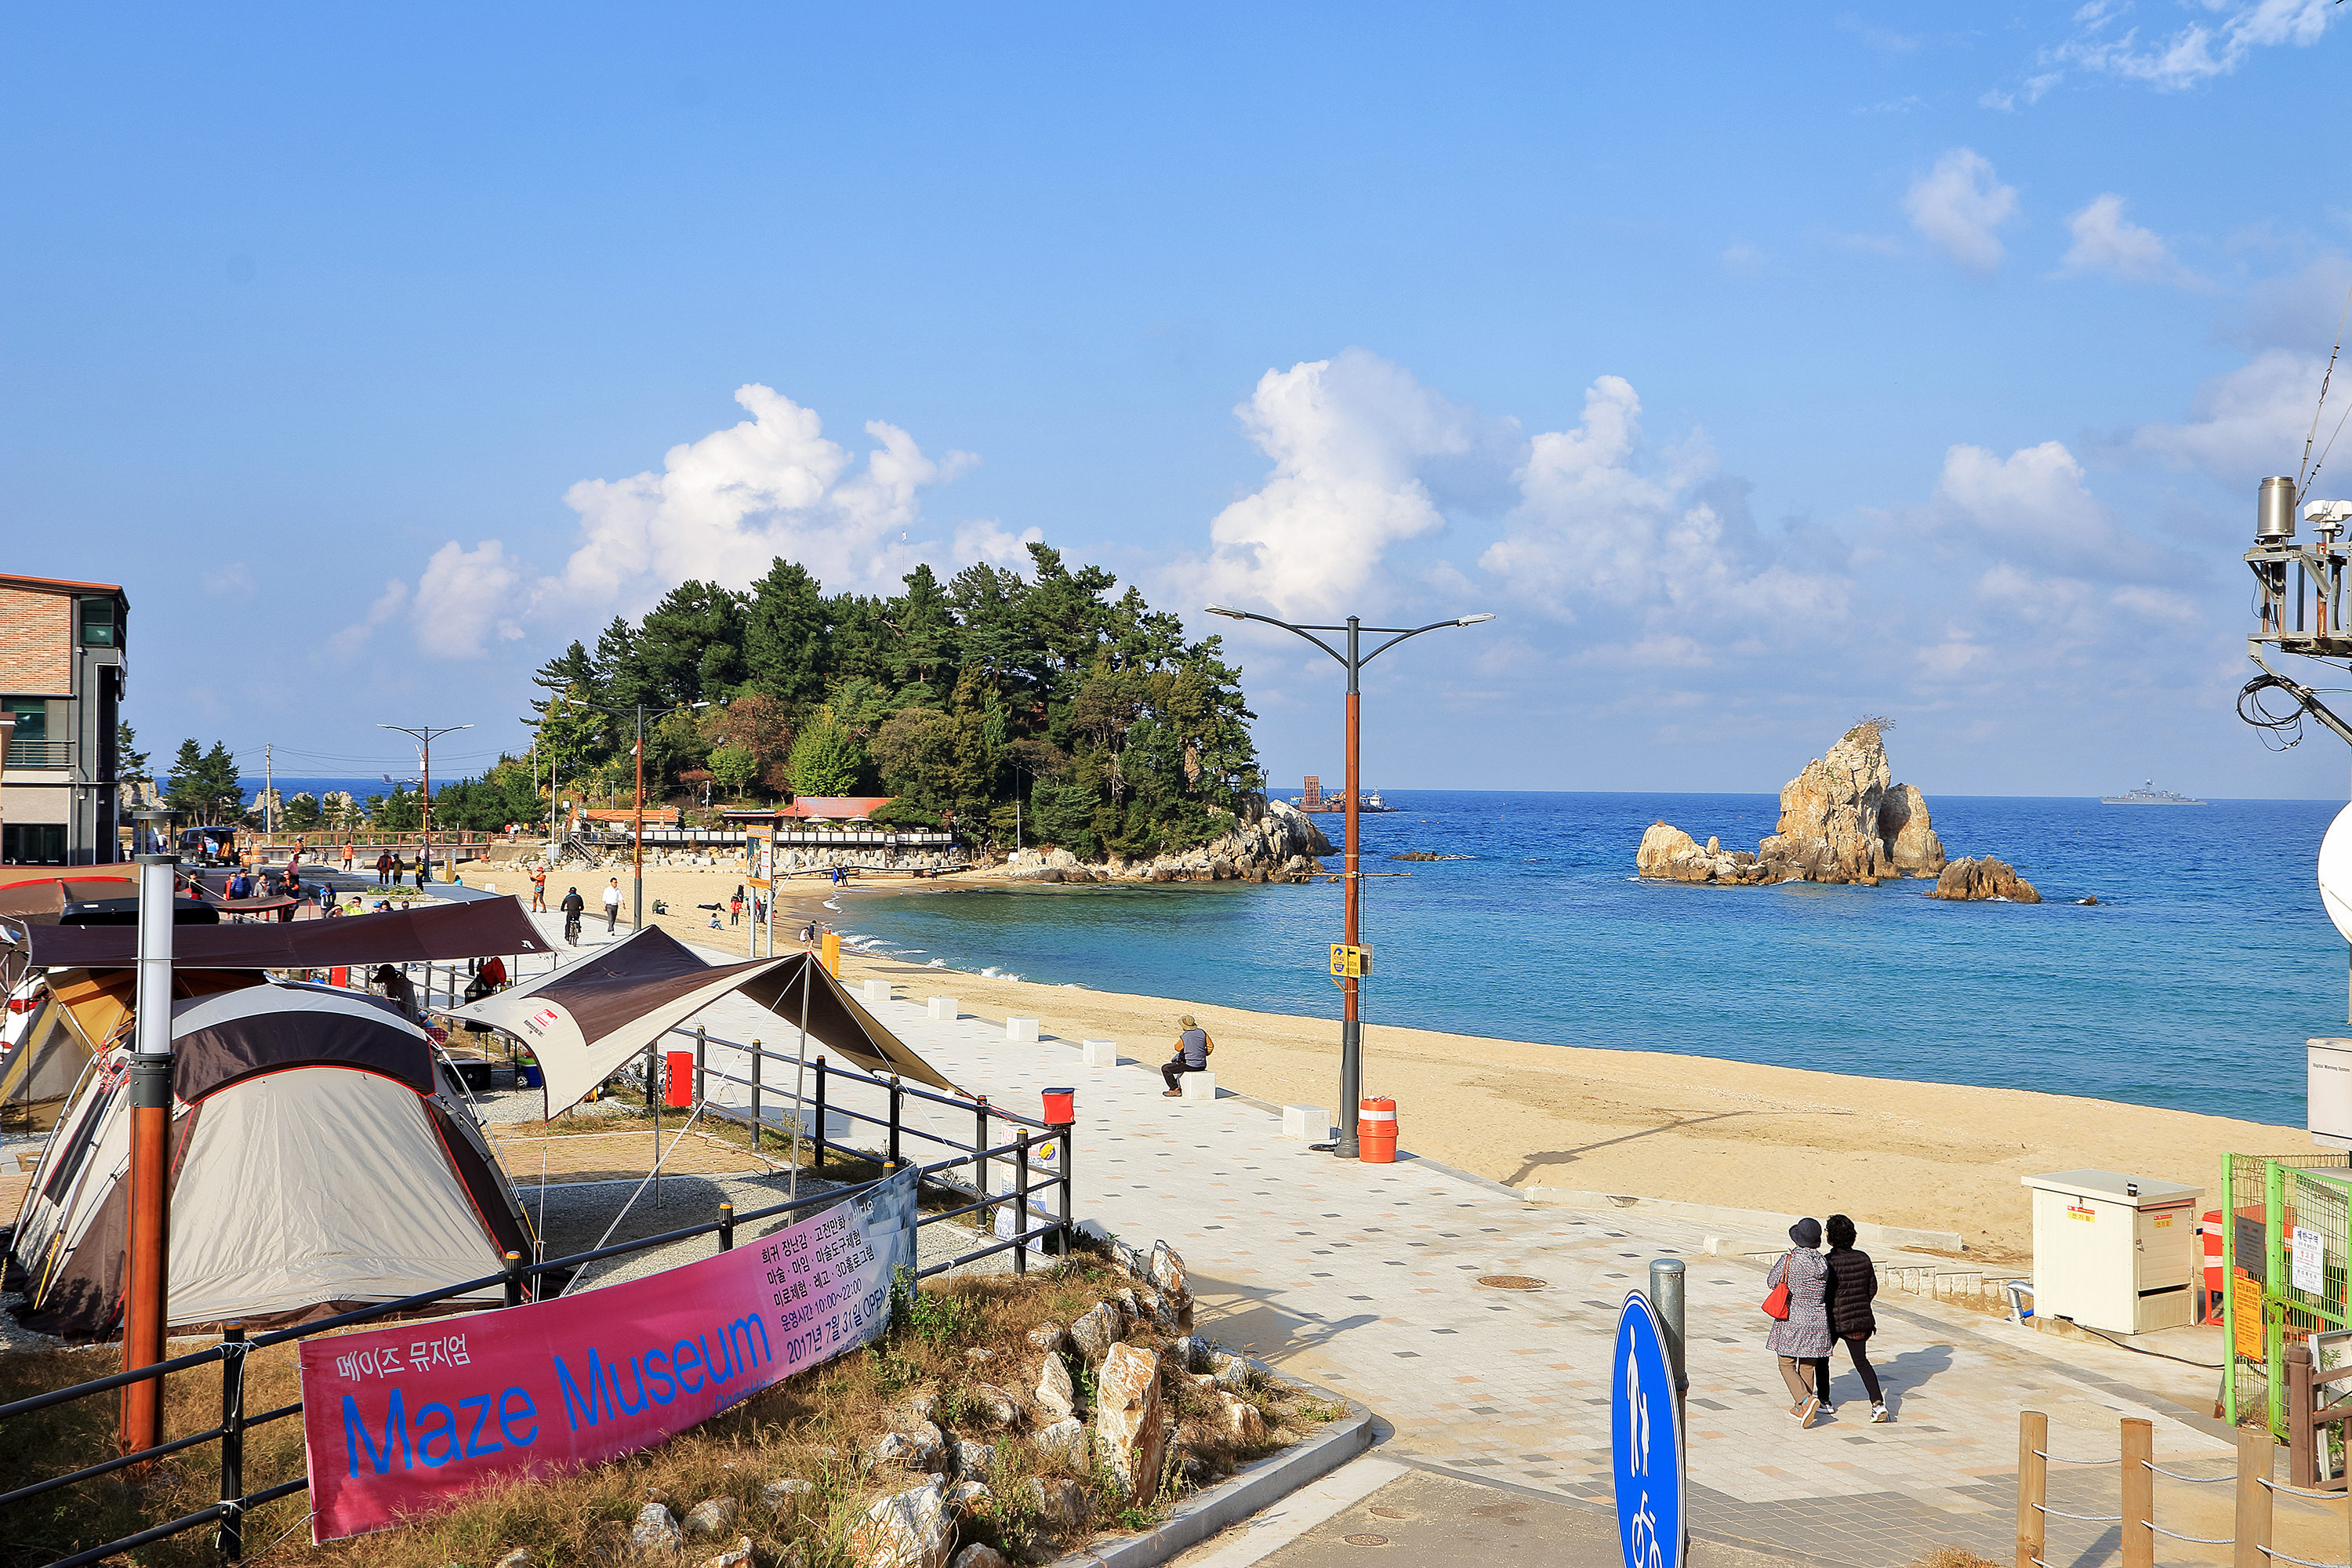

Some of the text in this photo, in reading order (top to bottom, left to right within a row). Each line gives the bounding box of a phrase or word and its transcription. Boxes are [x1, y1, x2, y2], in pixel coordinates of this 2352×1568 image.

[761, 1200, 874, 1265] 희귀 장난감 고전만화 비디오
[766, 1229, 862, 1287] 마술 마임 마술도구체험
[773, 1243, 876, 1308] 미로체험 레고 3D홀로그램
[781, 1277, 862, 1332] 운영시간 10:00~22:00
[786, 1324, 822, 1365] 2017년
[825, 1314, 840, 1345] 7월
[842, 1301, 863, 1333] 31일
[862, 1284, 887, 1319] OPEN
[336, 1332, 472, 1383] 메이즈 뮤지엄
[341, 1311, 772, 1480] Maze Museum
